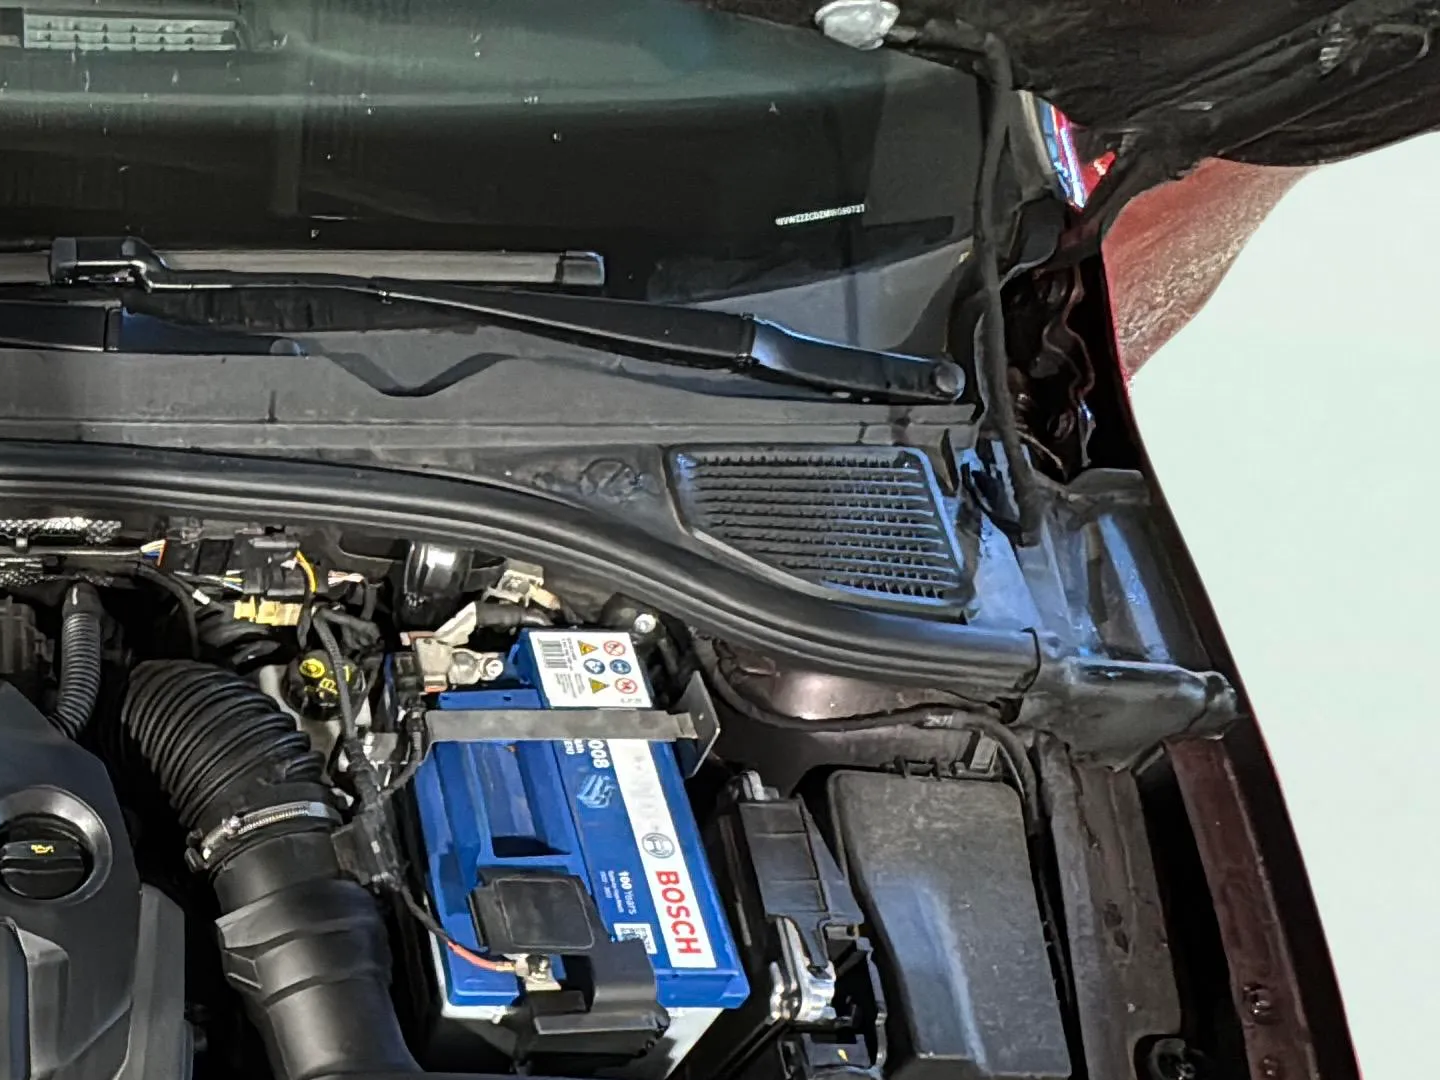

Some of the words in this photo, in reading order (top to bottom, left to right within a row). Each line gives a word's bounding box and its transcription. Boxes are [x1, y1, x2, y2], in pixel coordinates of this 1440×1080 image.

[618, 871, 632, 890] 100
[624, 890, 637, 915] Years
[656, 871, 702, 953] BOSCH
